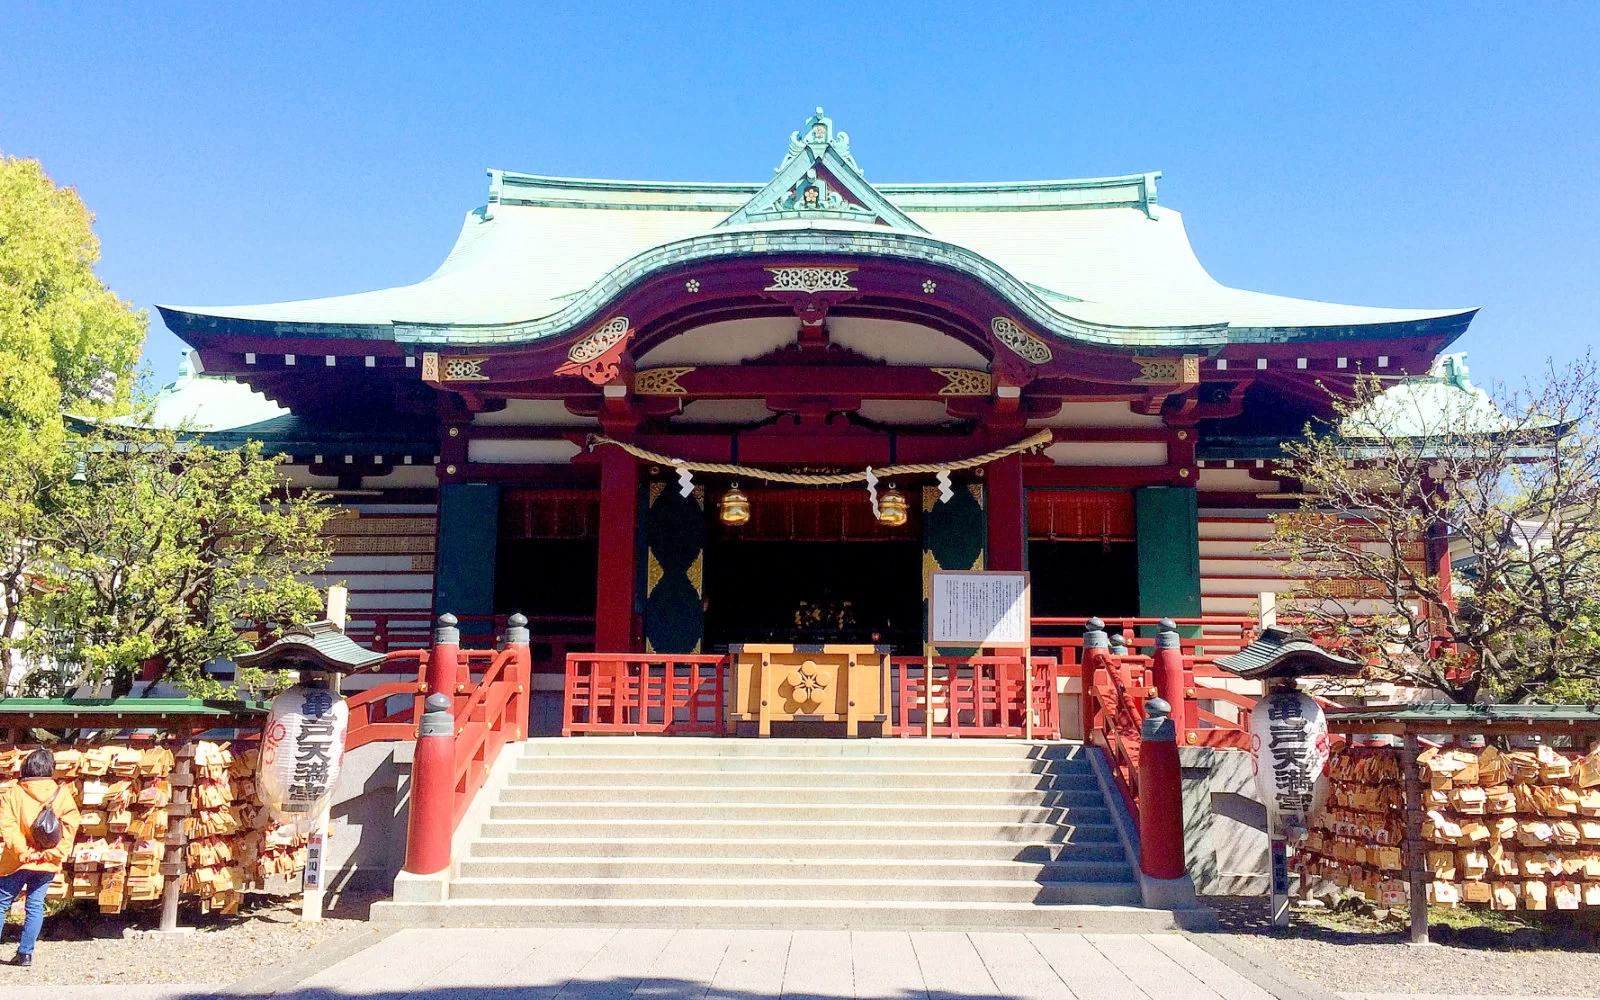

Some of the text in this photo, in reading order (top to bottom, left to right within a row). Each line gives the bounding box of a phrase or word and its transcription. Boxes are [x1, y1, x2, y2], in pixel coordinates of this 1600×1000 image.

[288, 690, 338, 801] 亀戸天満宮
[1268, 693, 1314, 811] 亀戸天満宮
